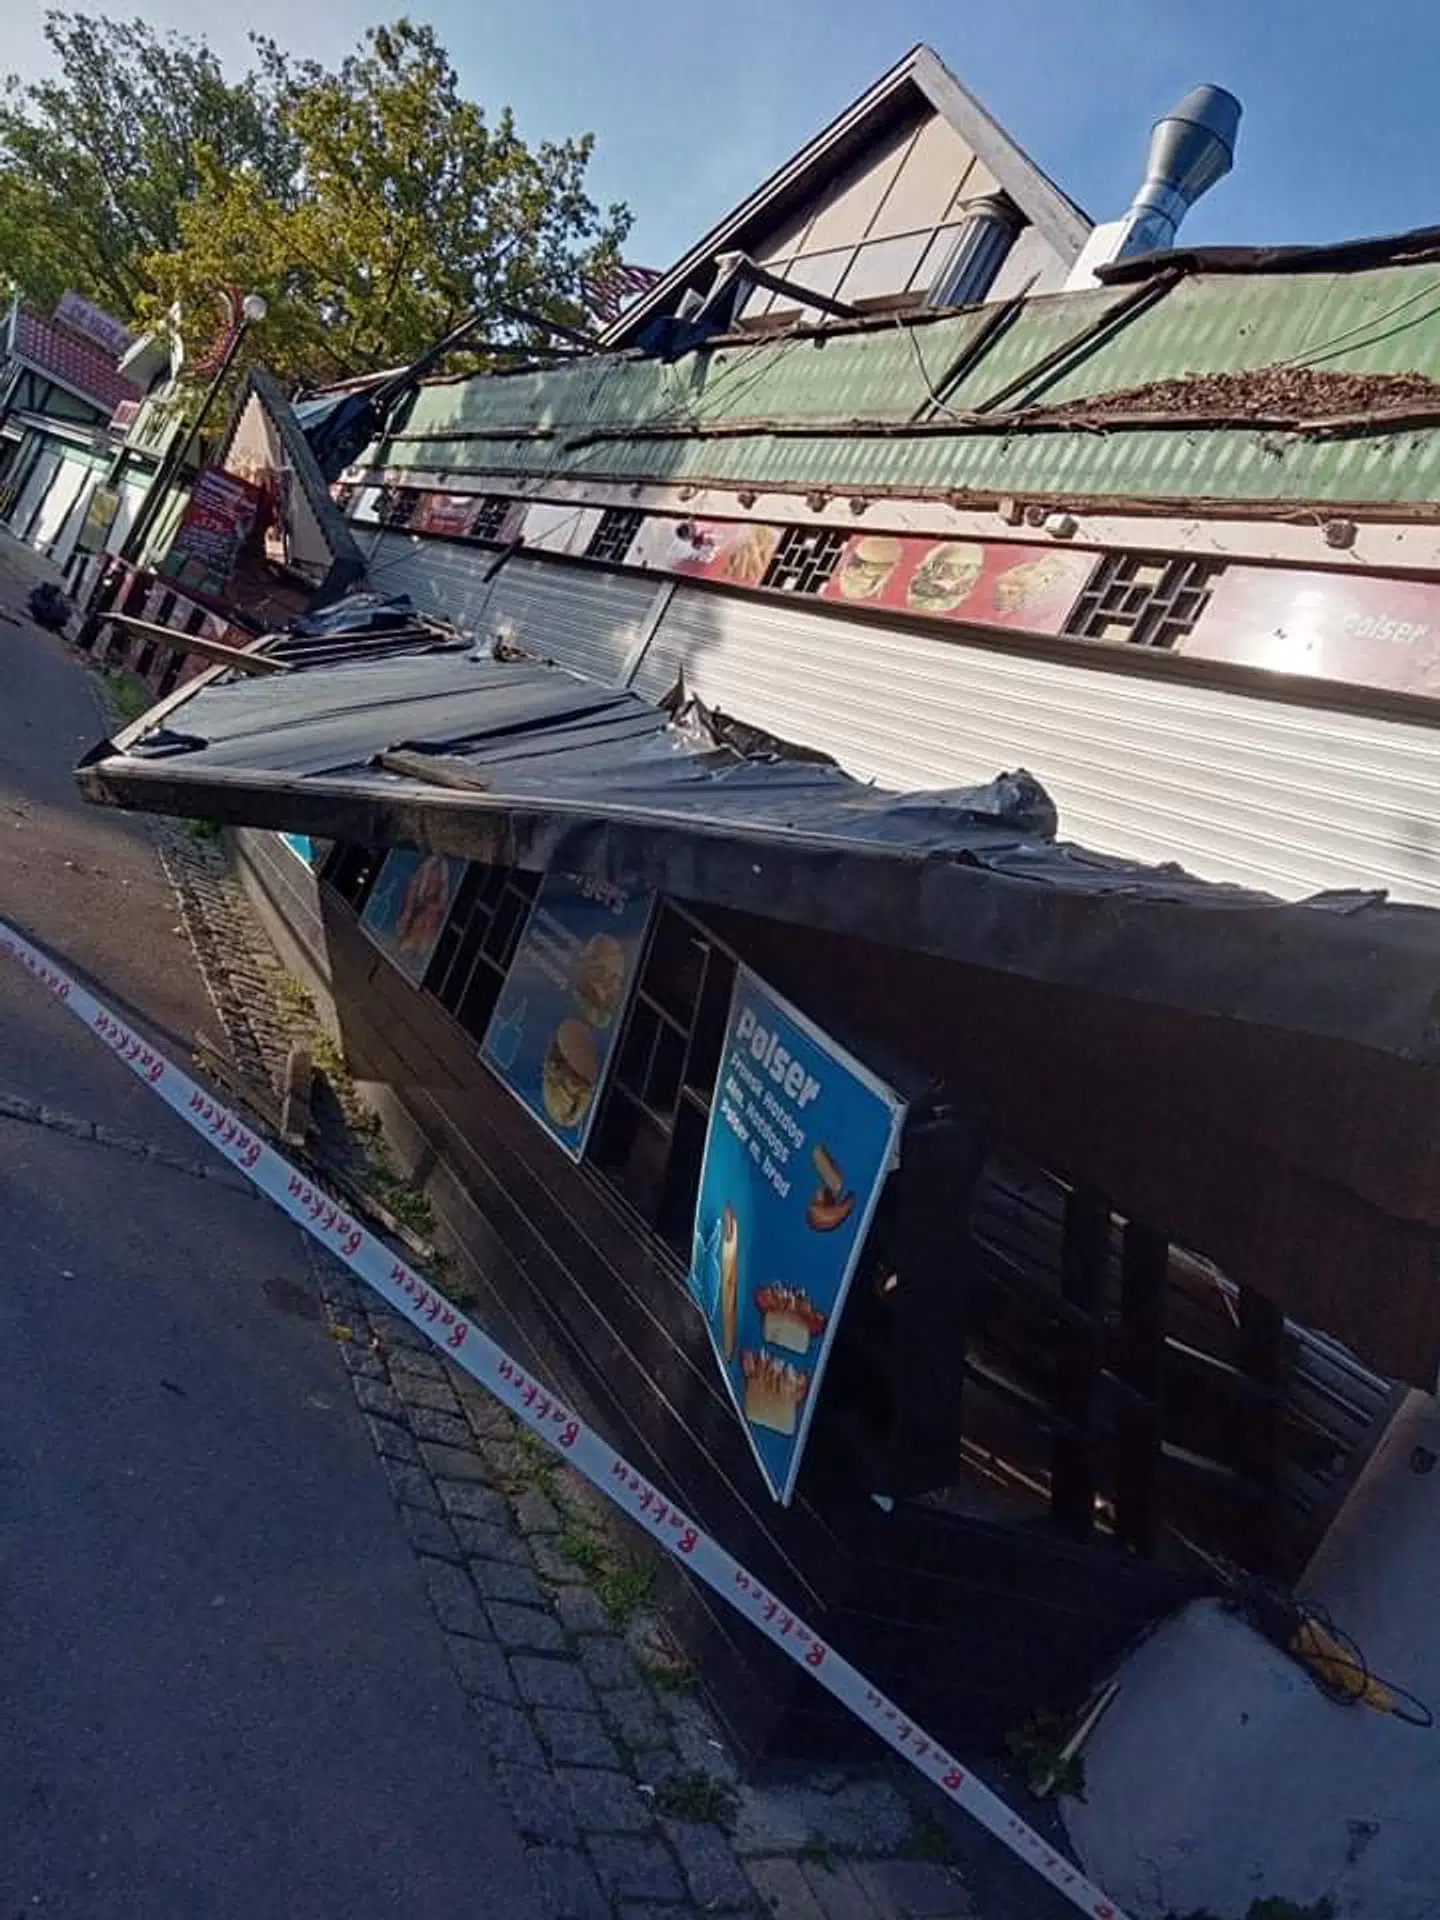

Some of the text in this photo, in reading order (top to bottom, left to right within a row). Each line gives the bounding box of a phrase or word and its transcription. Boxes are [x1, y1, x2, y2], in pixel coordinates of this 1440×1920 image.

[95, 1012, 164, 1083] Bakken
[189, 1090, 262, 1168] Bakken
[288, 1174, 363, 1256] Bakken
[389, 1263, 468, 1349] Bakken
[499, 1358, 579, 1448] Bakken
[609, 1460, 698, 1553] Bakken
[735, 1570, 827, 1666] Bakken
